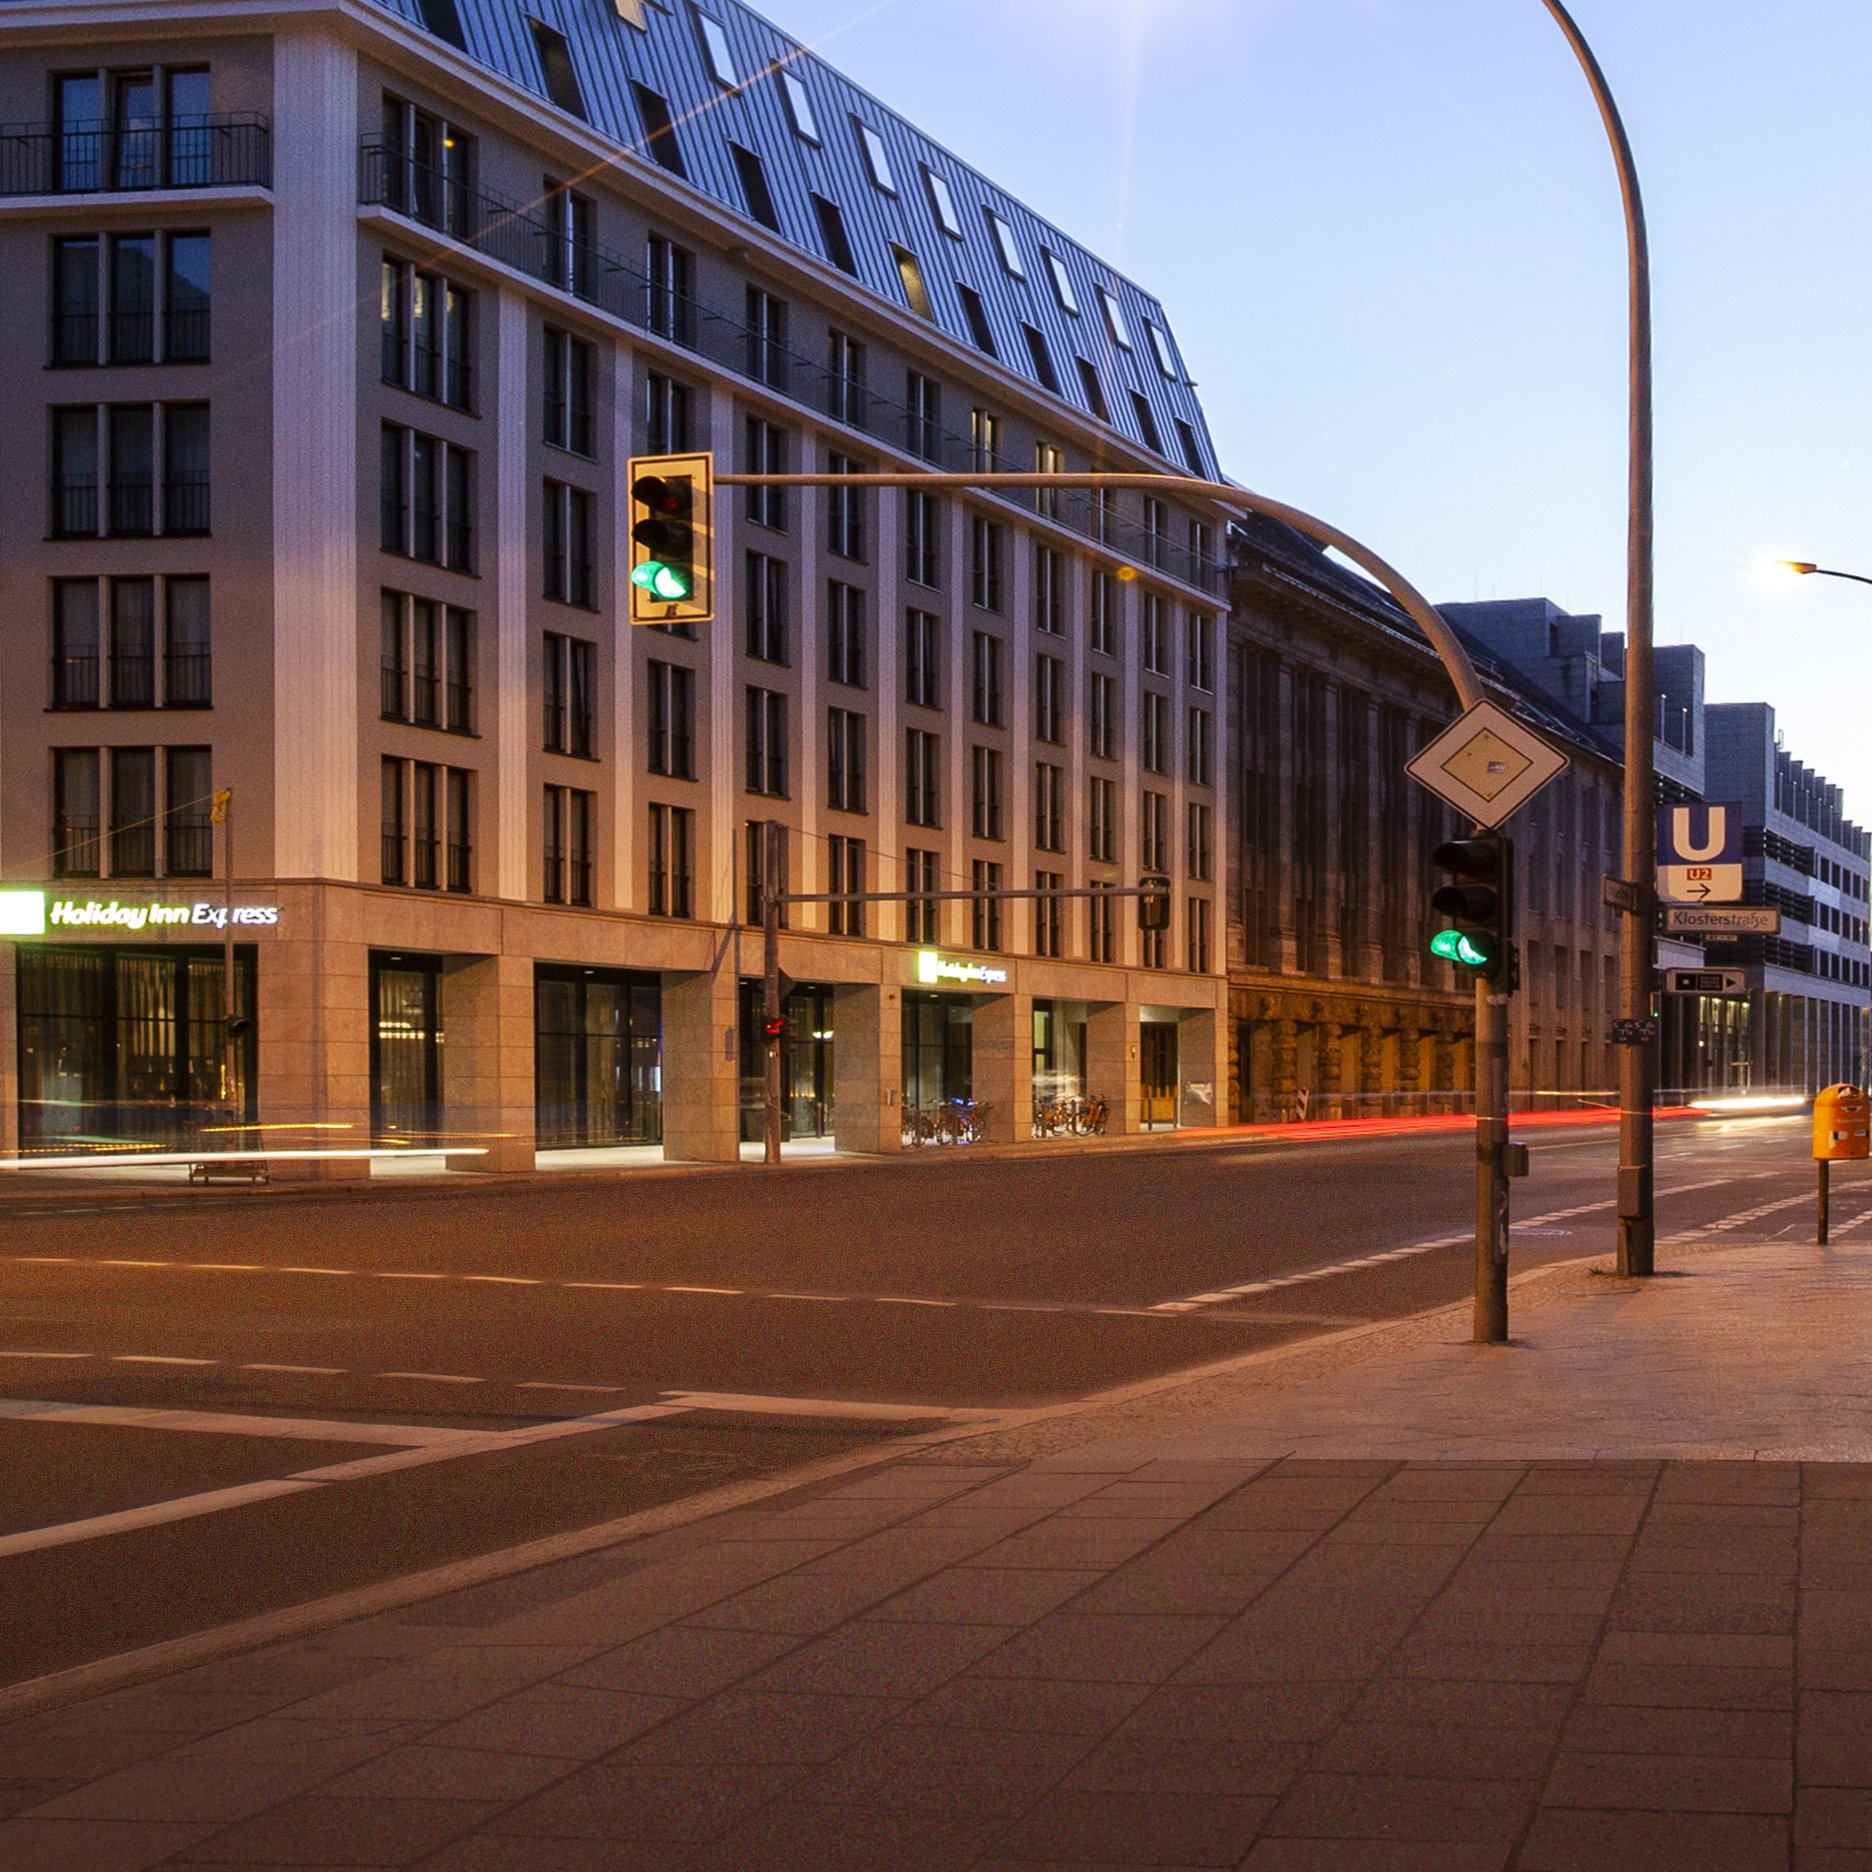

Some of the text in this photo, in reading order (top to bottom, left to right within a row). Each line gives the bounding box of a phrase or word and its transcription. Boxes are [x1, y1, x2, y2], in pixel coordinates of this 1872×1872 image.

[1673, 806, 1726, 862] U
[1690, 870, 1711, 880] U2
[50, 901, 147, 929] Holiday
[149, 904, 191, 925] Inn
[1673, 911, 1769, 928] Klosterstraße
